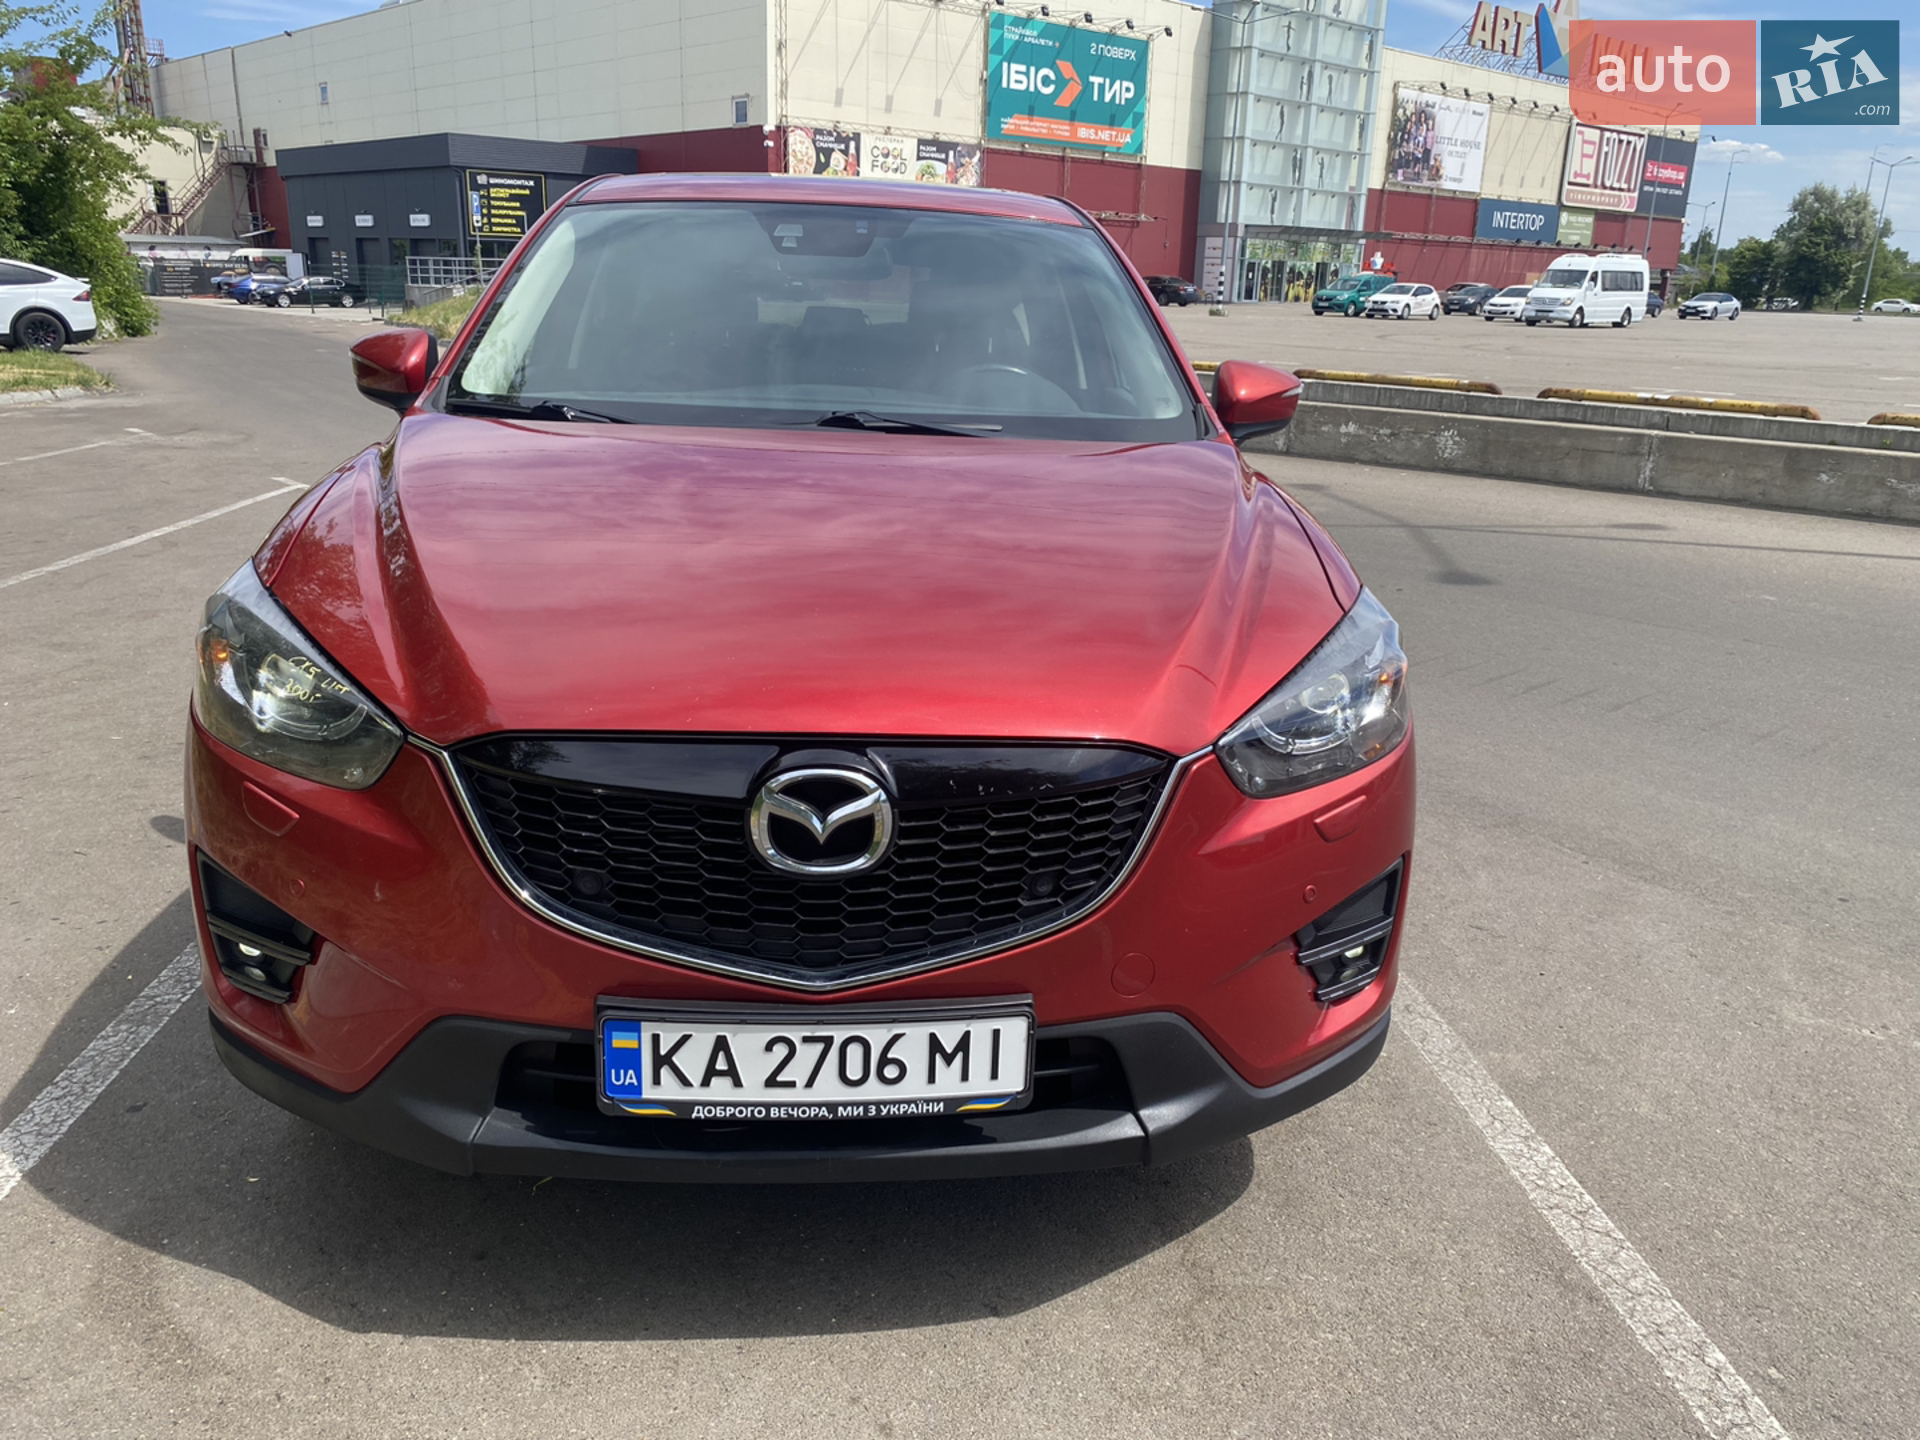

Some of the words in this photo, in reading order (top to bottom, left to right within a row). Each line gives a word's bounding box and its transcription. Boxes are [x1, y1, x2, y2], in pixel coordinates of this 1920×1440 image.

[1468, 1, 1534, 57] ART
[1090, 42, 1097, 55] 2
[1098, 45, 1136, 61] ПОВЕРХ
[1001, 61, 1056, 95] ІБІС
[1089, 75, 1135, 105] ТИР
[815, 134, 835, 142] РАЗОМ
[1077, 127, 1132, 143] IBIS.NET.UA
[1435, 135, 1458, 147] LITTLE
[1460, 138, 1482, 150] HOUSE
[870, 145, 907, 161] COOL
[1597, 131, 1645, 190] FOZZY
[871, 160, 907, 175] FOOD
[1492, 210, 1545, 231] INTERTOP
[651, 1033, 744, 1088] KA
[764, 1032, 907, 1088] 2706
[927, 1028, 1001, 1084] MI
[611, 1068, 638, 1086] UA
[692, 1106, 766, 1119] ДОБРОГО
[770, 1105, 833, 1119] ВЕЧОРА,
[838, 1104, 864, 1117] МИ
[868, 1104, 876, 1116] З
[880, 1100, 944, 1116] УКРАЇНИ
